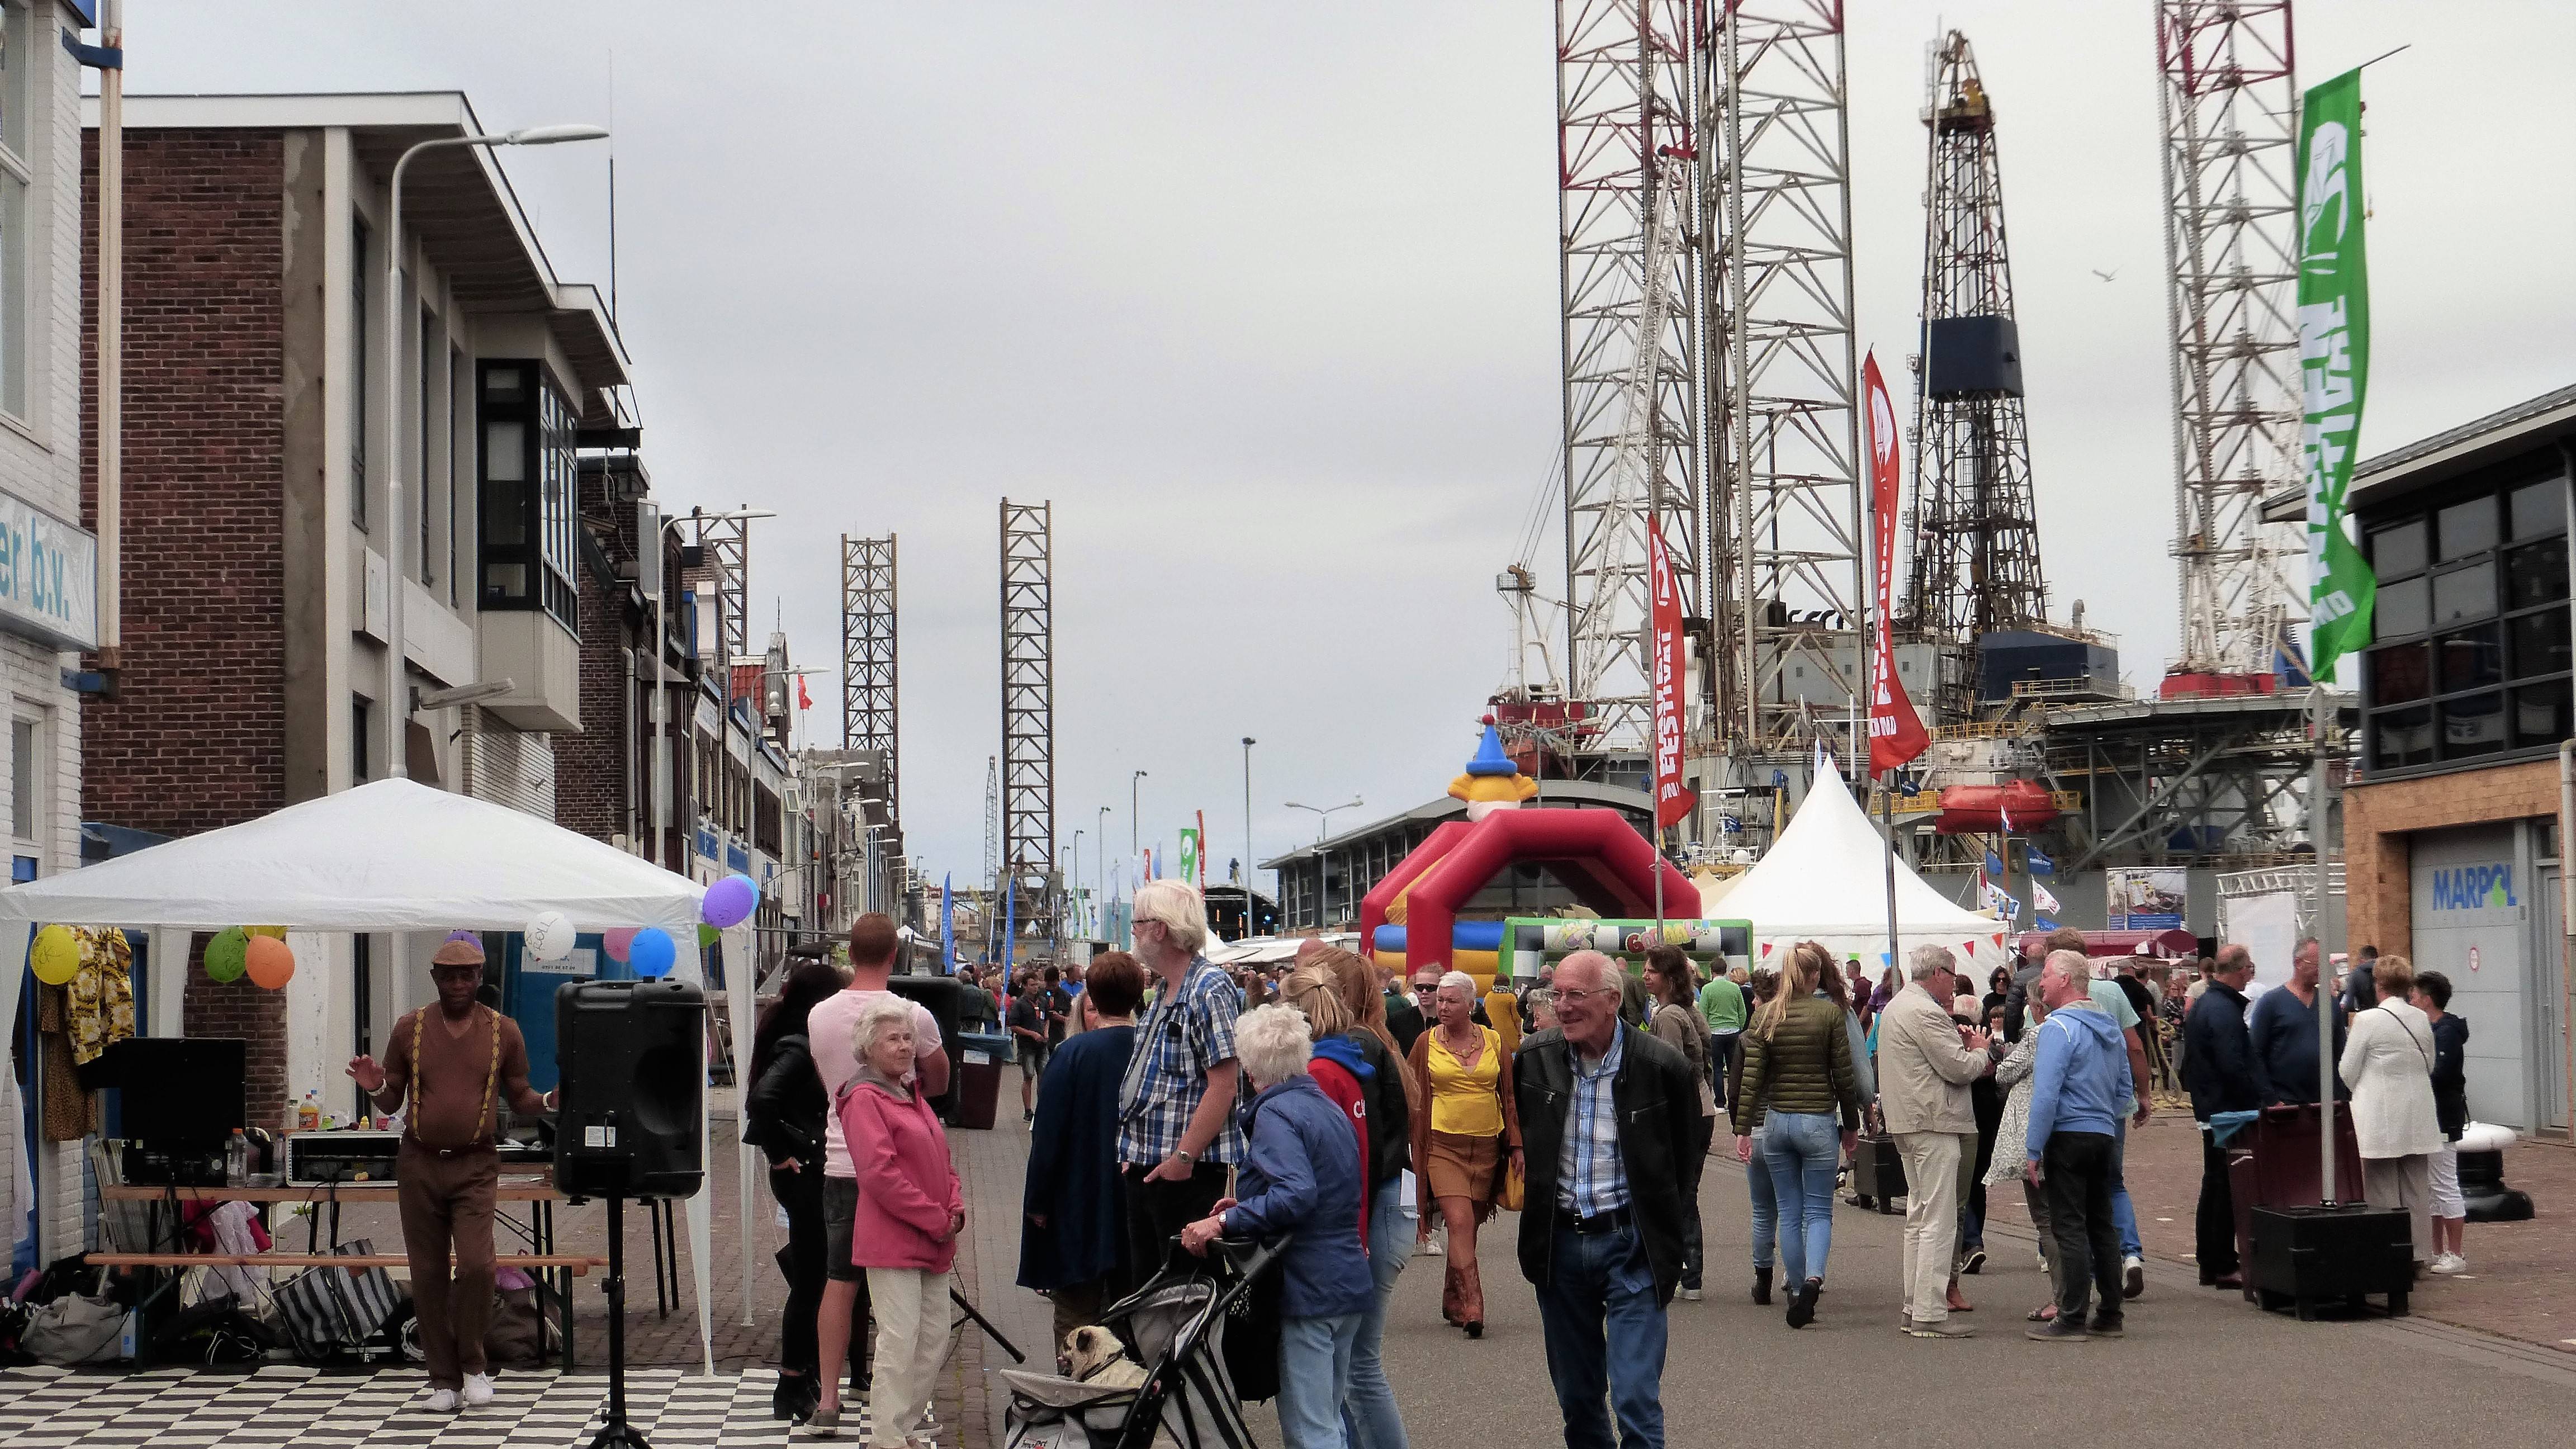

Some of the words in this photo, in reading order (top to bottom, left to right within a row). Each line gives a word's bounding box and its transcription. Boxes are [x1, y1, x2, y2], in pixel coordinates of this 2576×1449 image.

[31, 517, 70, 622] b.v.
[2432, 863, 2517, 911] MARPOL
[532, 917, 559, 951] ROLL
